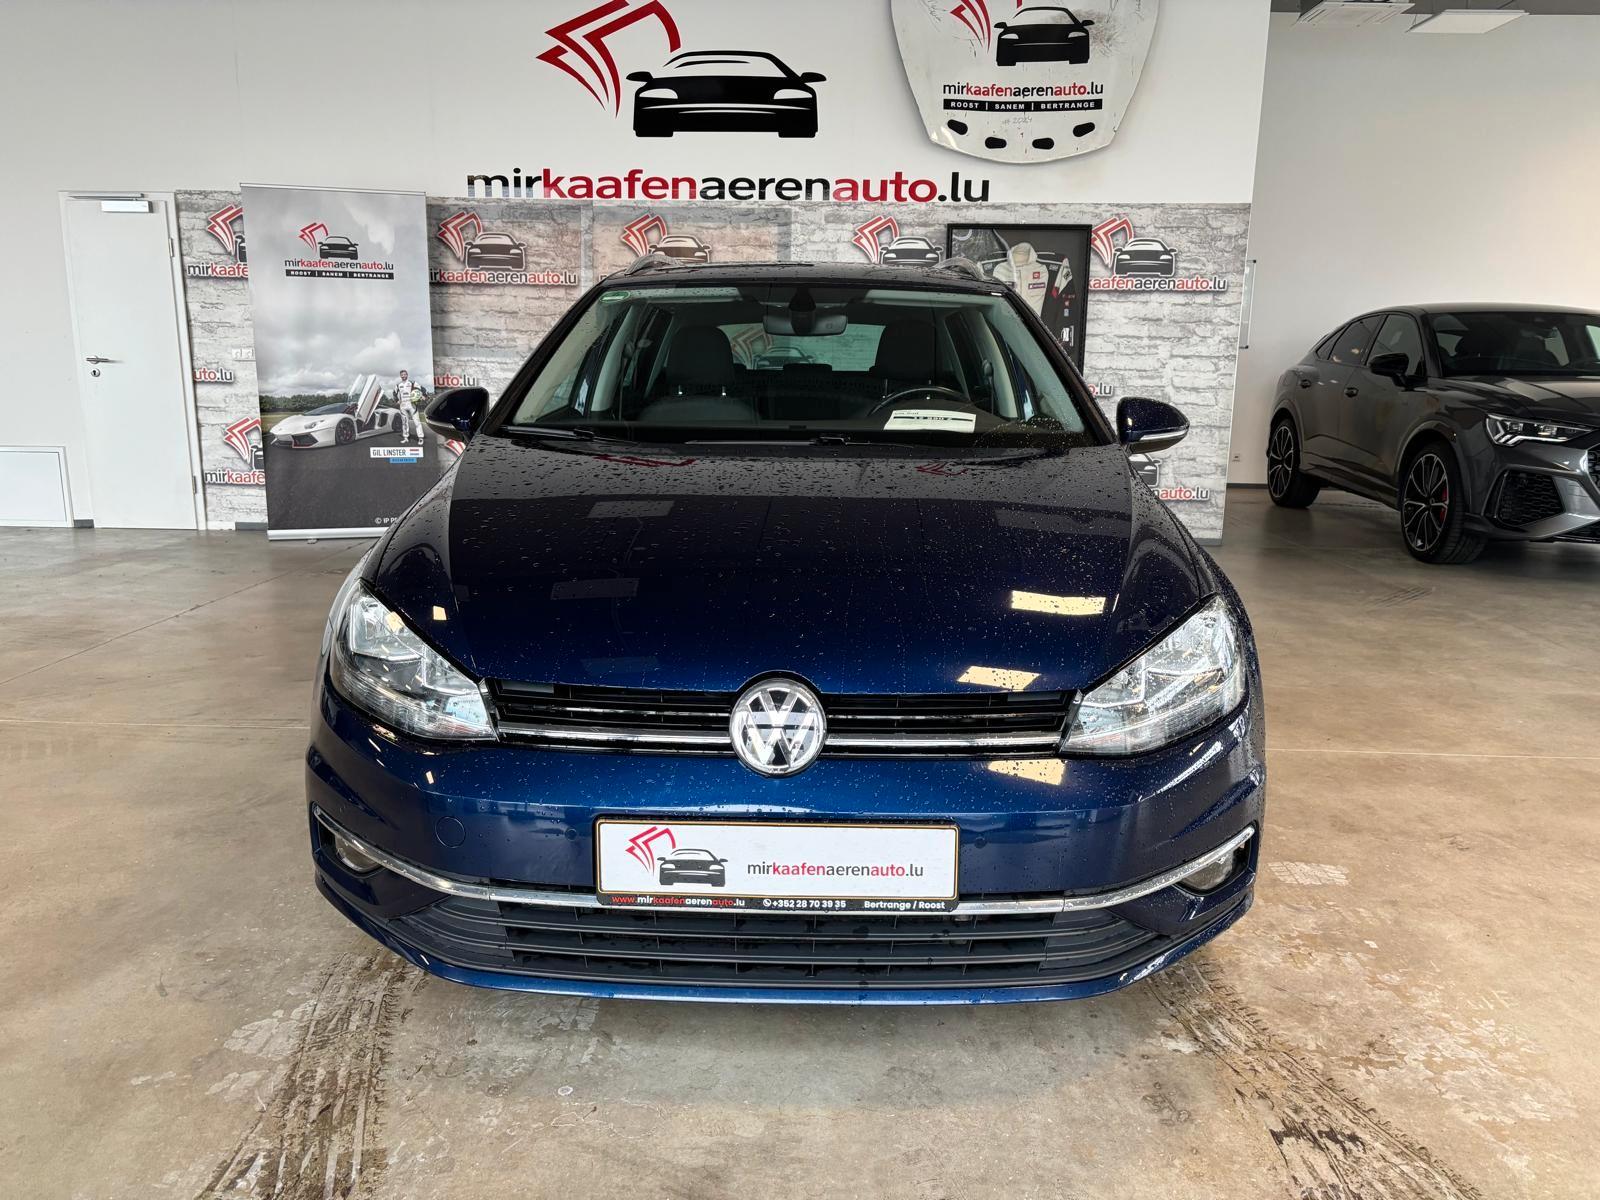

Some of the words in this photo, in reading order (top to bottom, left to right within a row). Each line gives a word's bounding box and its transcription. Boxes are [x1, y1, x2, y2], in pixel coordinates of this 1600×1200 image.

[943, 82, 1104, 98] mirkaafenaerenauto.lu
[950, 101, 979, 109] ROOST
[1040, 101, 1095, 110] BERTRANGE
[467, 168, 990, 203] mirkaafenaerenauto.lu
[187, 262, 249, 277] mirkaafe
[284, 258, 394, 271] mirkaafenaerenauto.lu
[434, 373, 476, 387] uto.lu
[372, 449, 382, 457] GIL
[383, 449, 407, 457] LINSTER
[204, 469, 266, 483] mirkaafe
[747, 861, 924, 877] mirkaafenaerenauto.lu
[772, 900, 795, 909] +352
[795, 900, 807, 908] 28
[809, 900, 820, 908] 70
[822, 901, 833, 909] 39
[834, 901, 846, 909] 35
[864, 900, 911, 911] Bertrange
[918, 901, 946, 909] Roost
